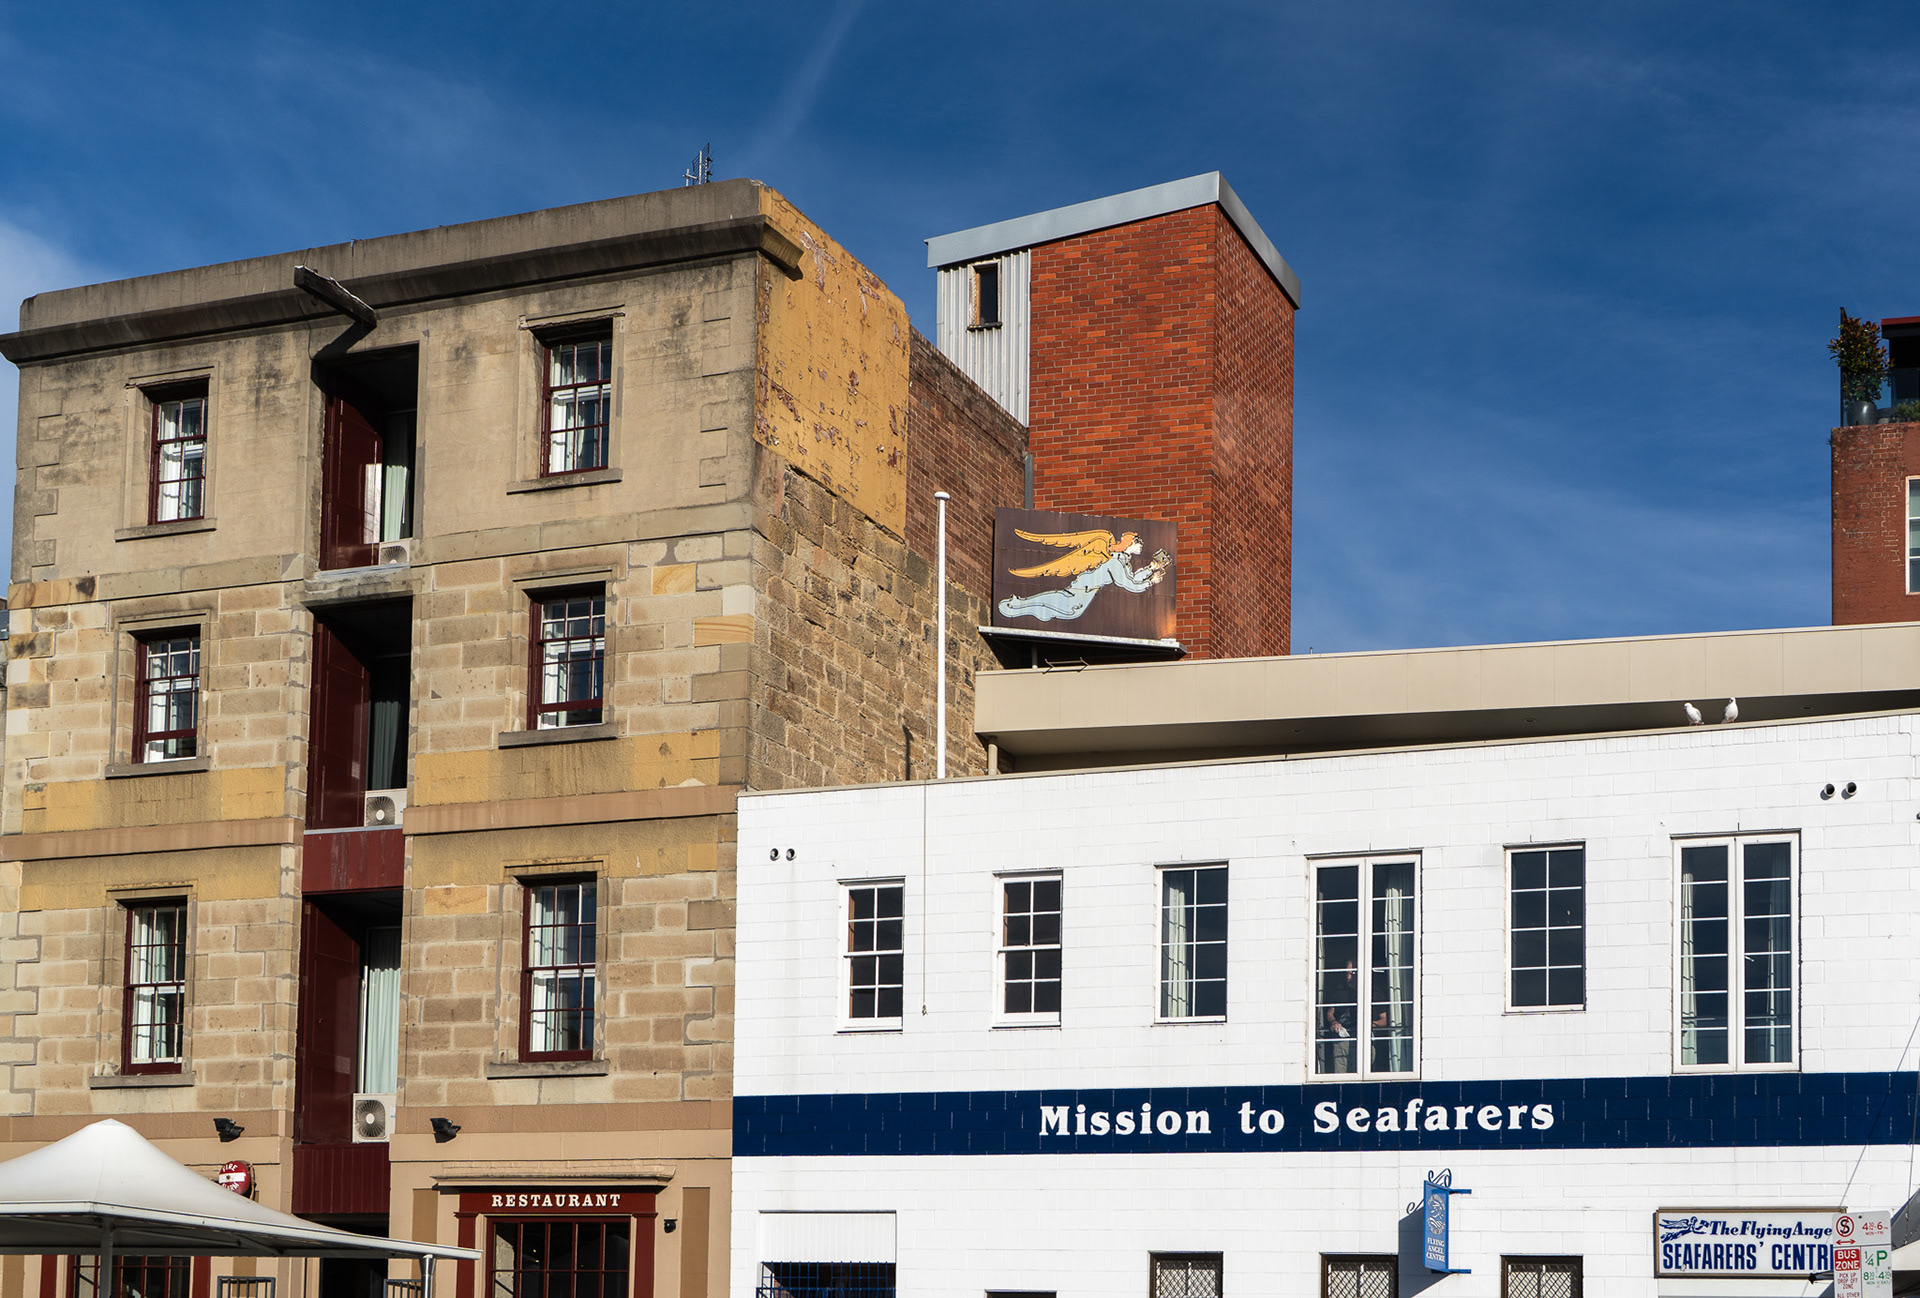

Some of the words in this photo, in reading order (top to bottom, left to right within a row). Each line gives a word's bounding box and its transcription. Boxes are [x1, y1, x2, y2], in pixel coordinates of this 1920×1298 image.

[1039, 1103, 1212, 1136] Mission
[1237, 1101, 1285, 1134] to
[1313, 1098, 1555, 1134] Seafarers
[222, 1163, 238, 1172] FIRE
[491, 1194, 621, 1207] RESTAURANT
[1792, 1220, 1833, 1239] Ange
[1427, 1237, 1445, 1247] FLYING
[1428, 1245, 1444, 1254] ANGEL
[1837, 1250, 1857, 1259] BUS
[1426, 1252, 1445, 1262] CENTRE
[1835, 1261, 1860, 1270] ZONE
